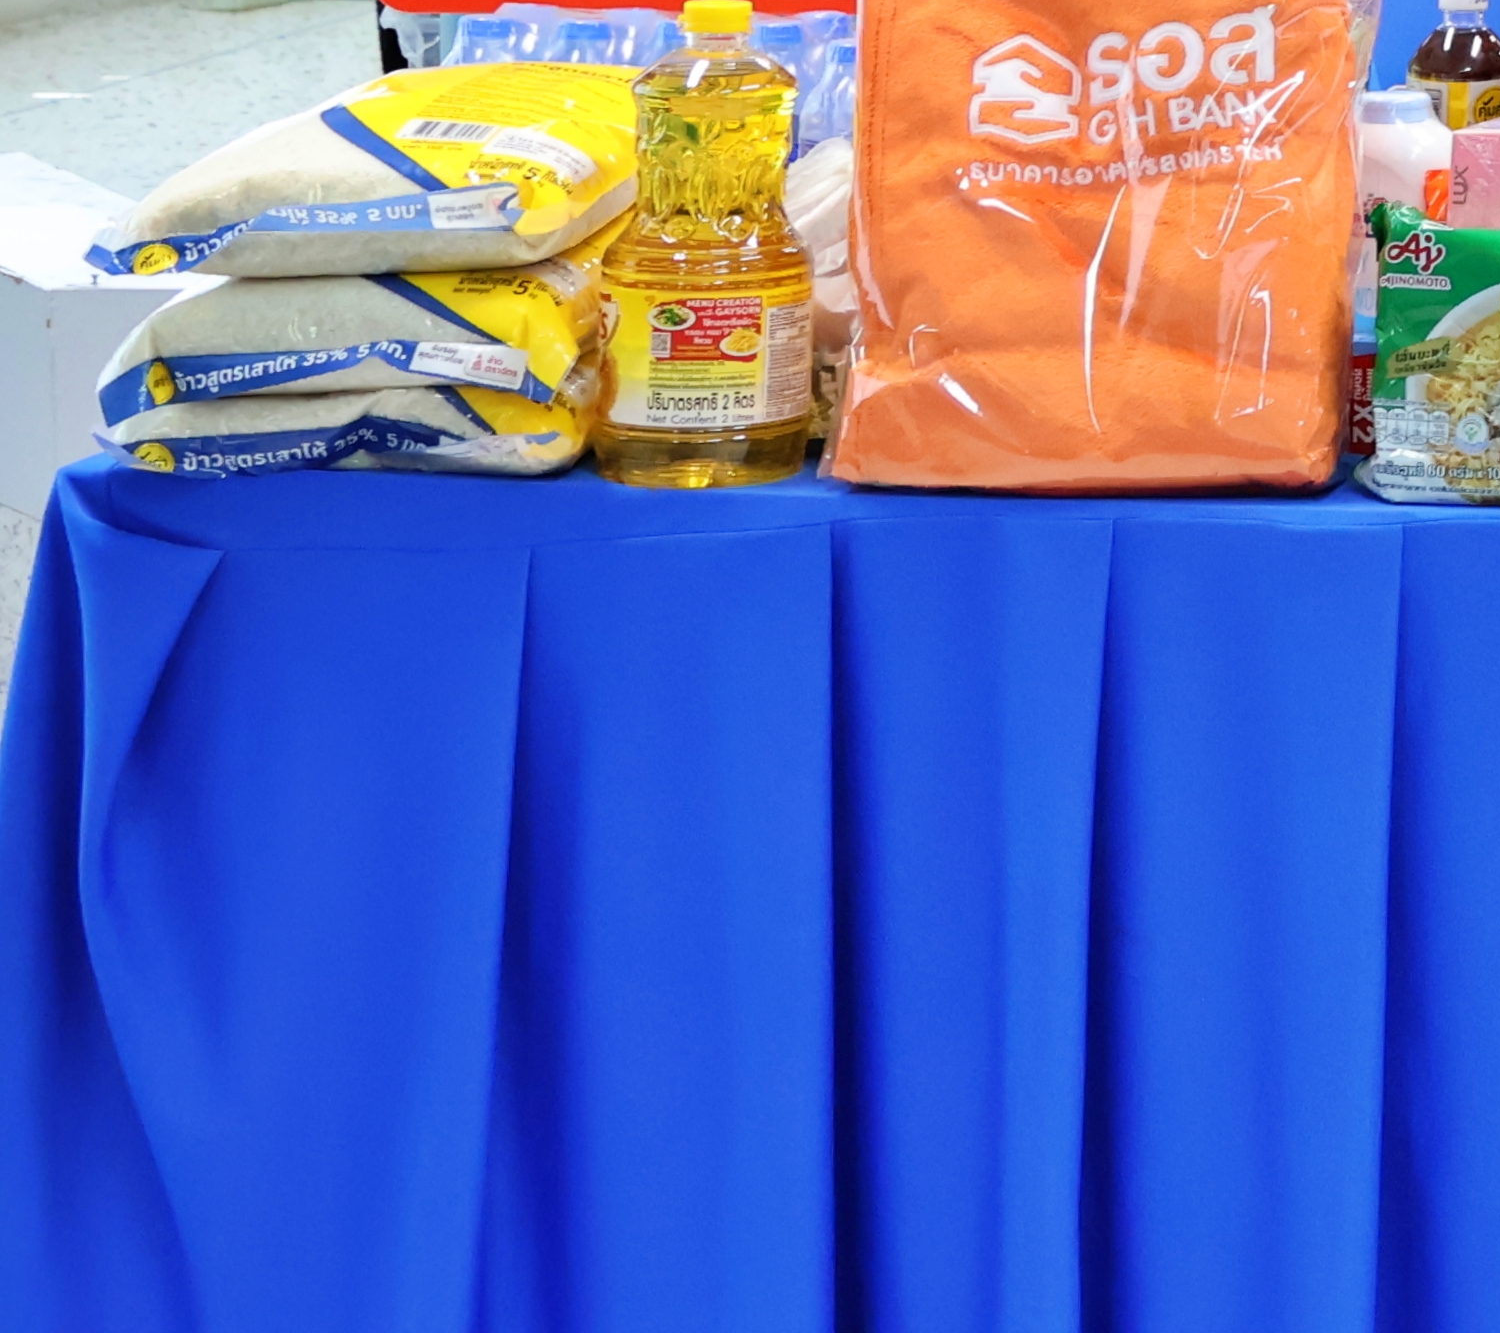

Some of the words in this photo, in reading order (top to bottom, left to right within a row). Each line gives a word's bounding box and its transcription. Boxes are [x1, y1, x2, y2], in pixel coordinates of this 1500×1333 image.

[1087, 4, 1278, 107] ธอส
[1168, 88, 1278, 133] BANK
[1451, 165, 1469, 205] LUX
[303, 347, 347, 368] 35%
[646, 391, 719, 416] ปริมาตรสุทธิ
